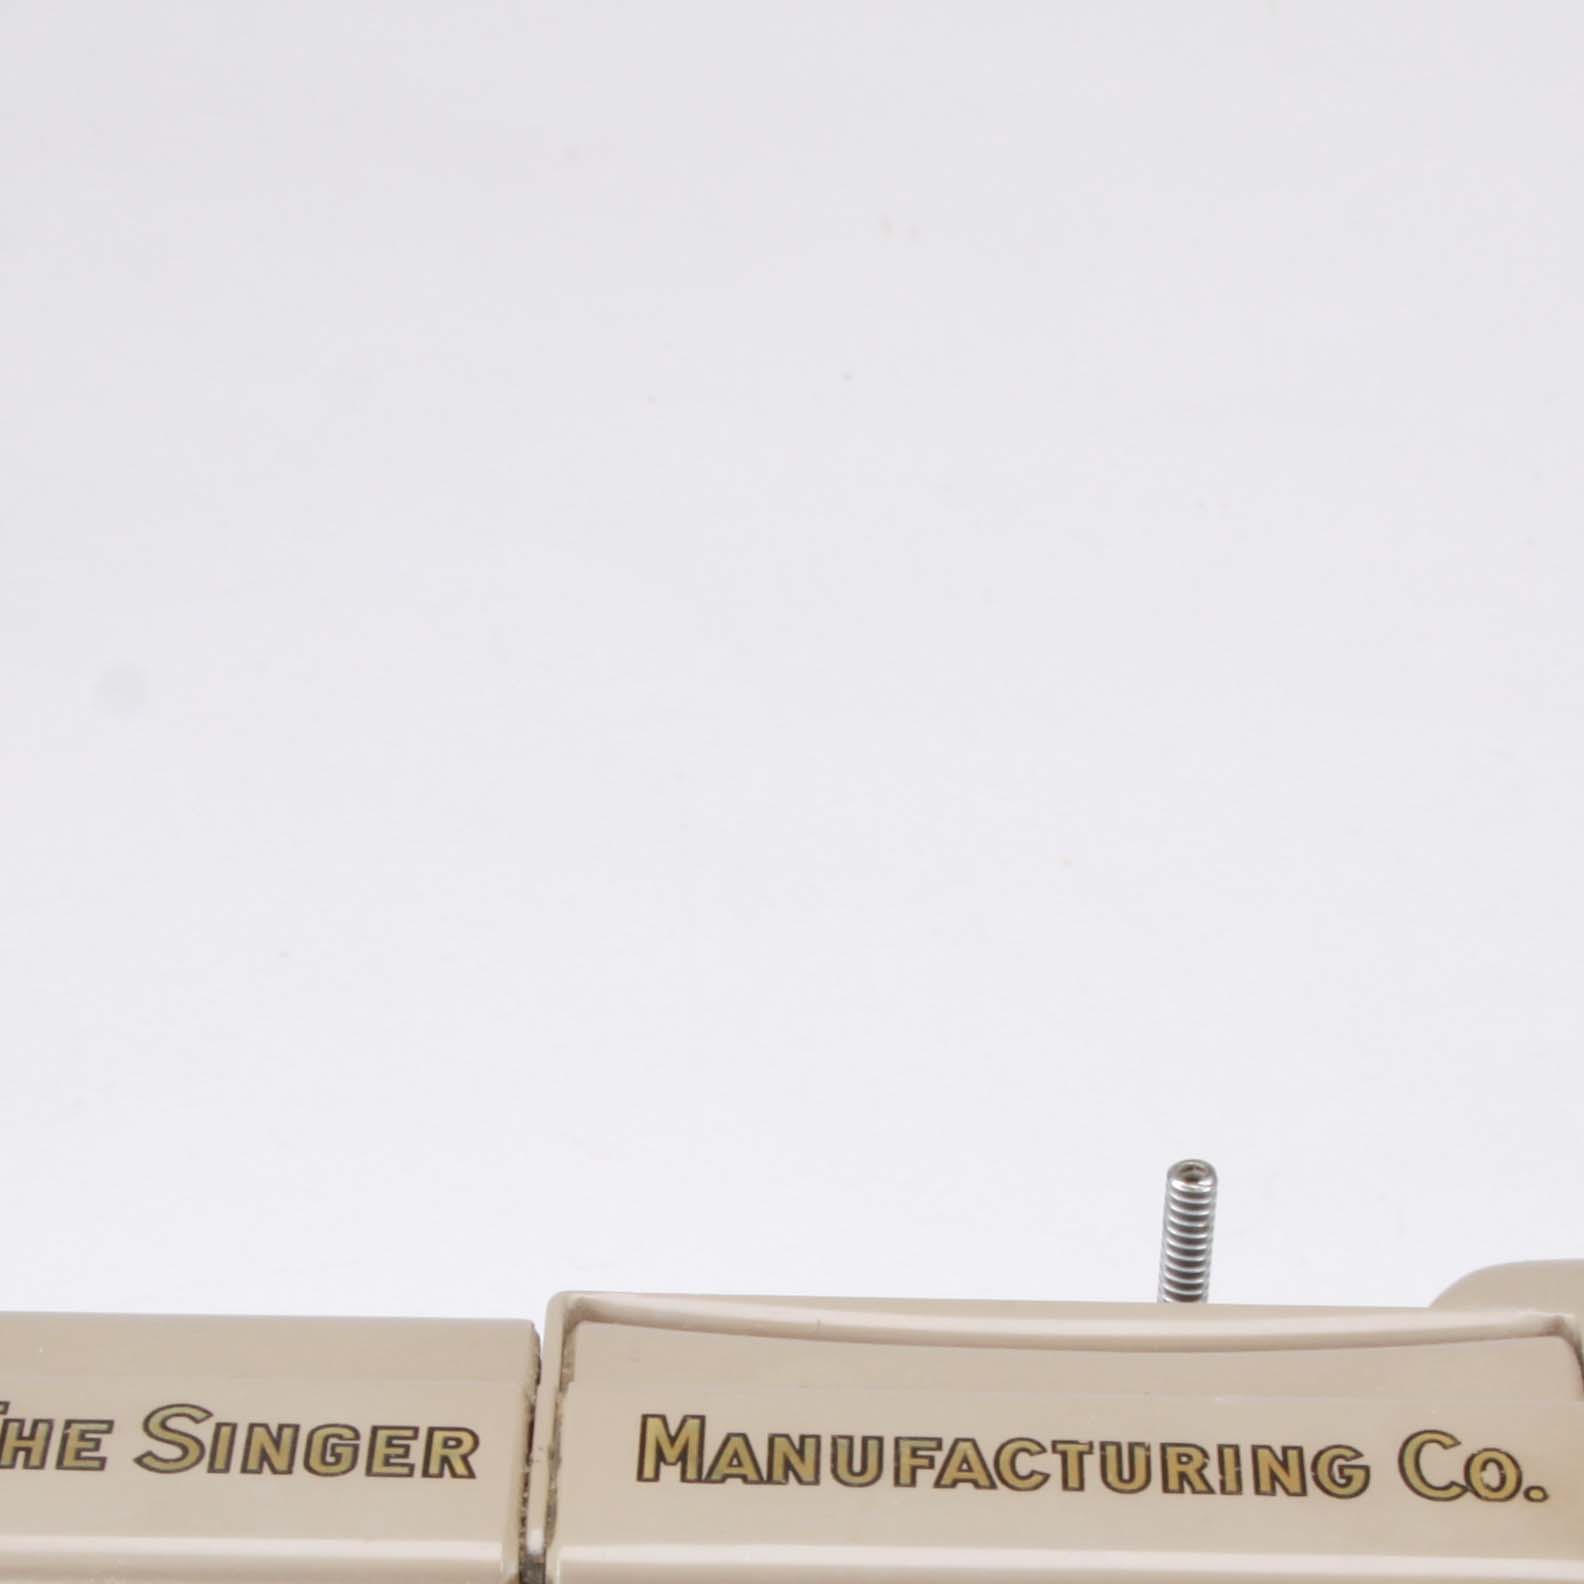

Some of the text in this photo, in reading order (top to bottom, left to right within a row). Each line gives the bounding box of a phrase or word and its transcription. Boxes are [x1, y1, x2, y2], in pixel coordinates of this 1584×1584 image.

[133, 1403, 480, 1479] SINGER
[636, 1413, 1371, 1499] MANUFACTURING
[1398, 1428, 1550, 1503] CO.
